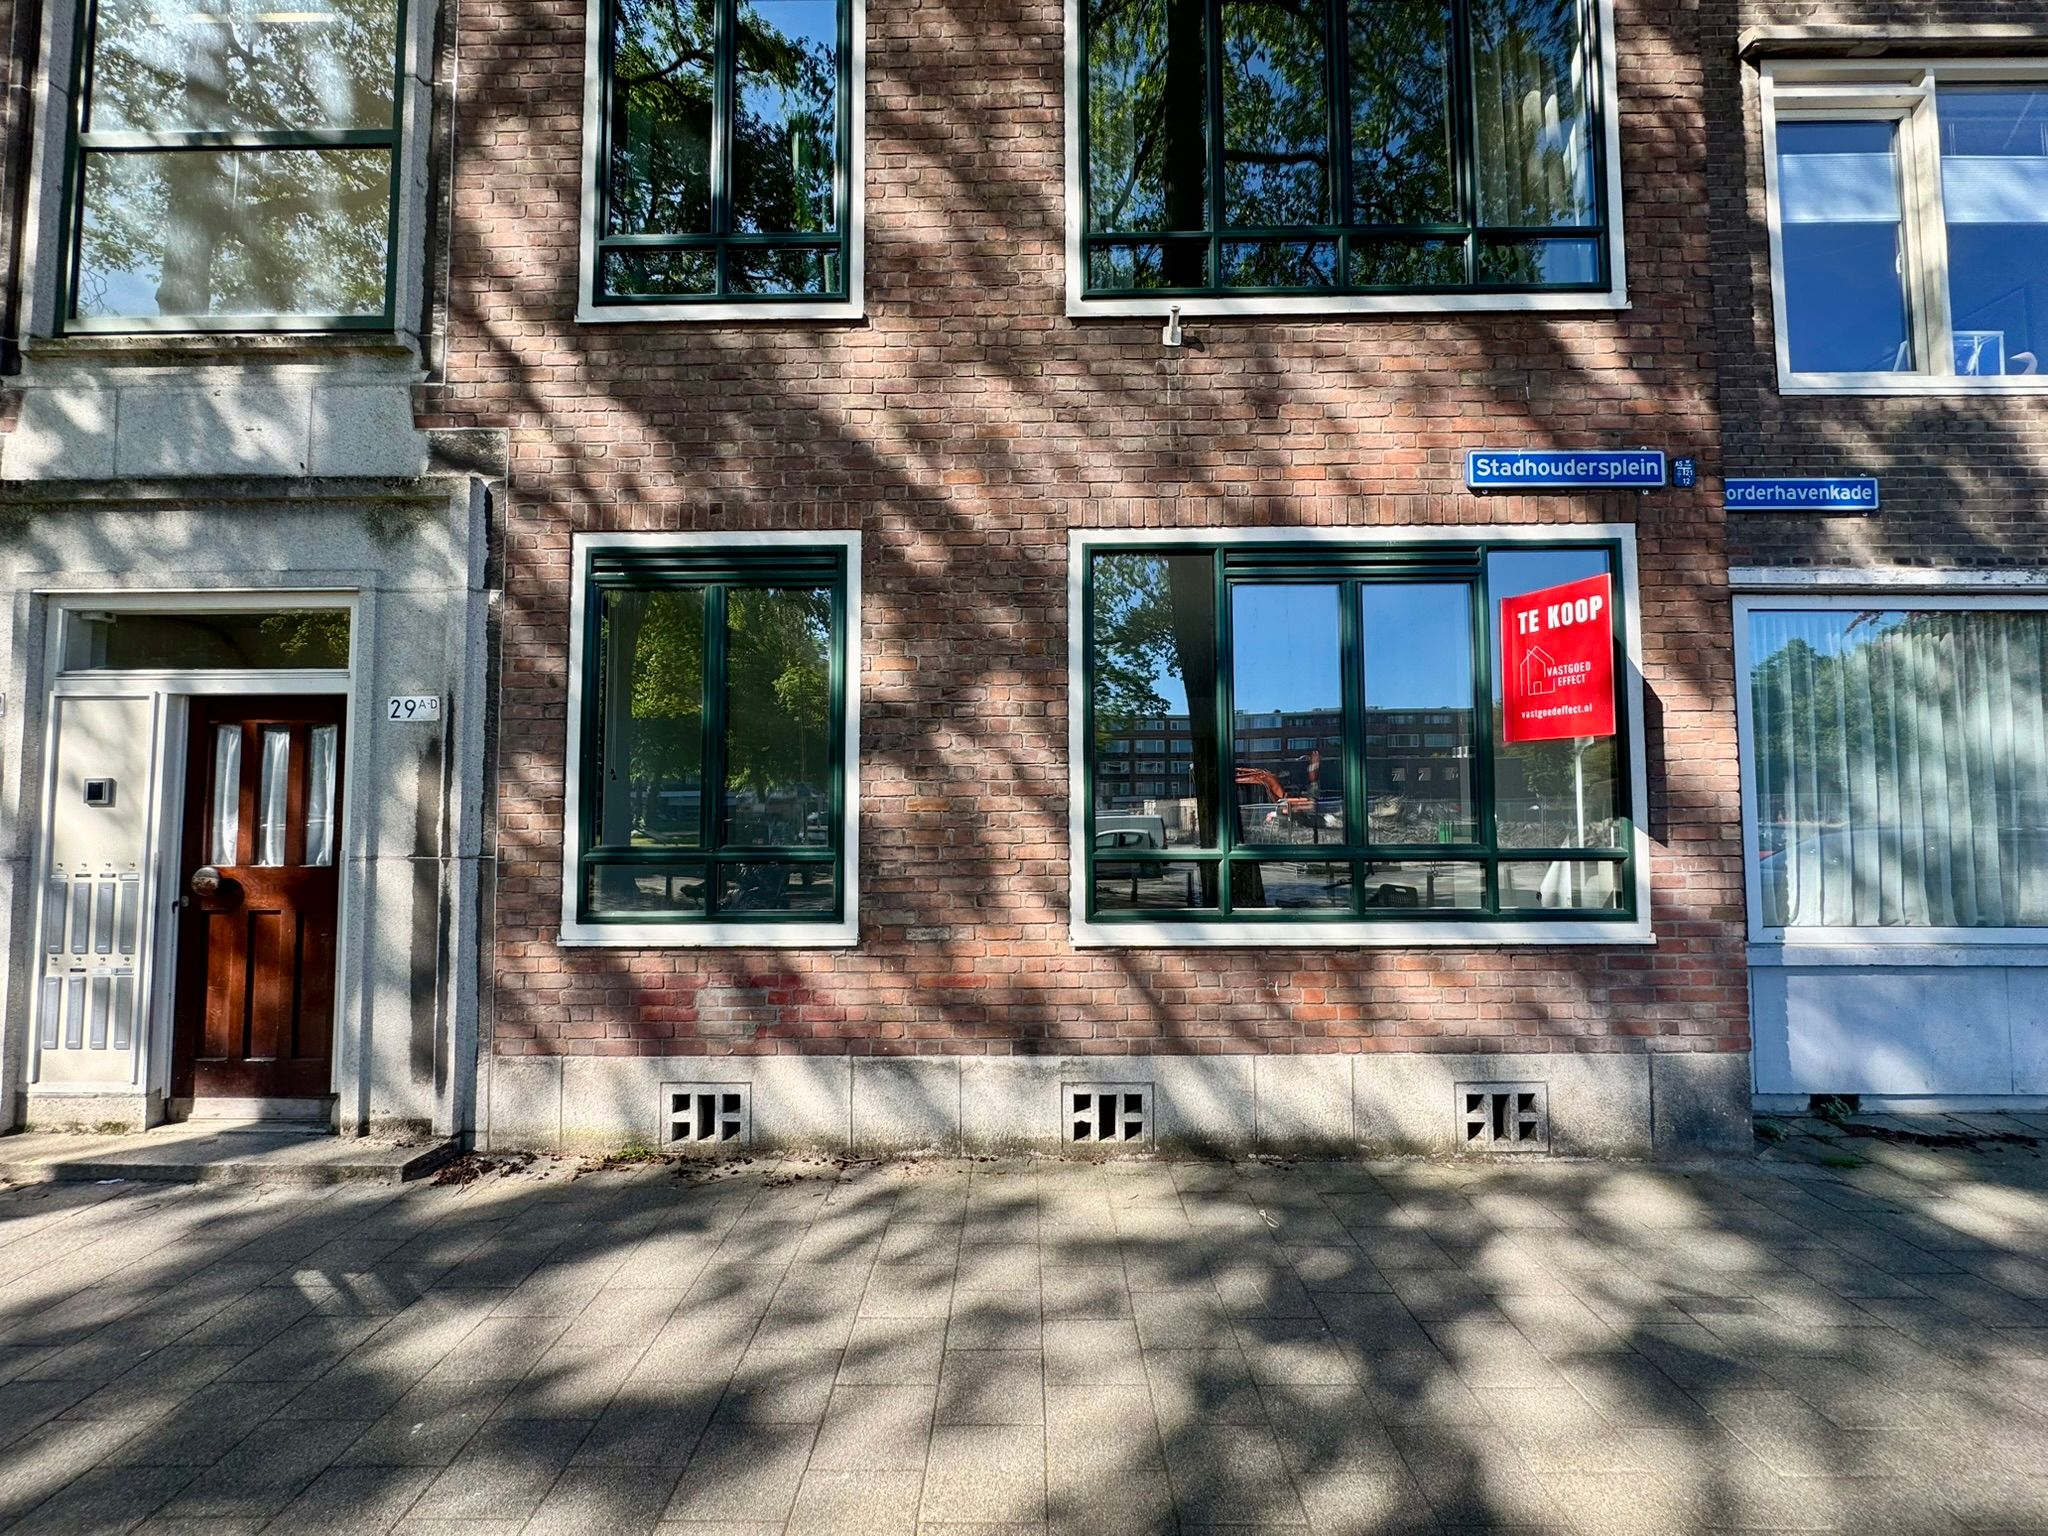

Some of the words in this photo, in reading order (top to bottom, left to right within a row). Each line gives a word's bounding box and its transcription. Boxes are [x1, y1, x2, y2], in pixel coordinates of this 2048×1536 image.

[1476, 457, 1659, 482] Stadhoudersplein
[1726, 484, 1872, 500] orderhavenkade
[1517, 609, 1539, 634] TE
[1547, 595, 1602, 629] KOOP
[1546, 661, 1591, 676] VASTGOED
[1557, 674, 1586, 686] EFFECT
[1521, 703, 1592, 719] vastgoedeffect.nl
